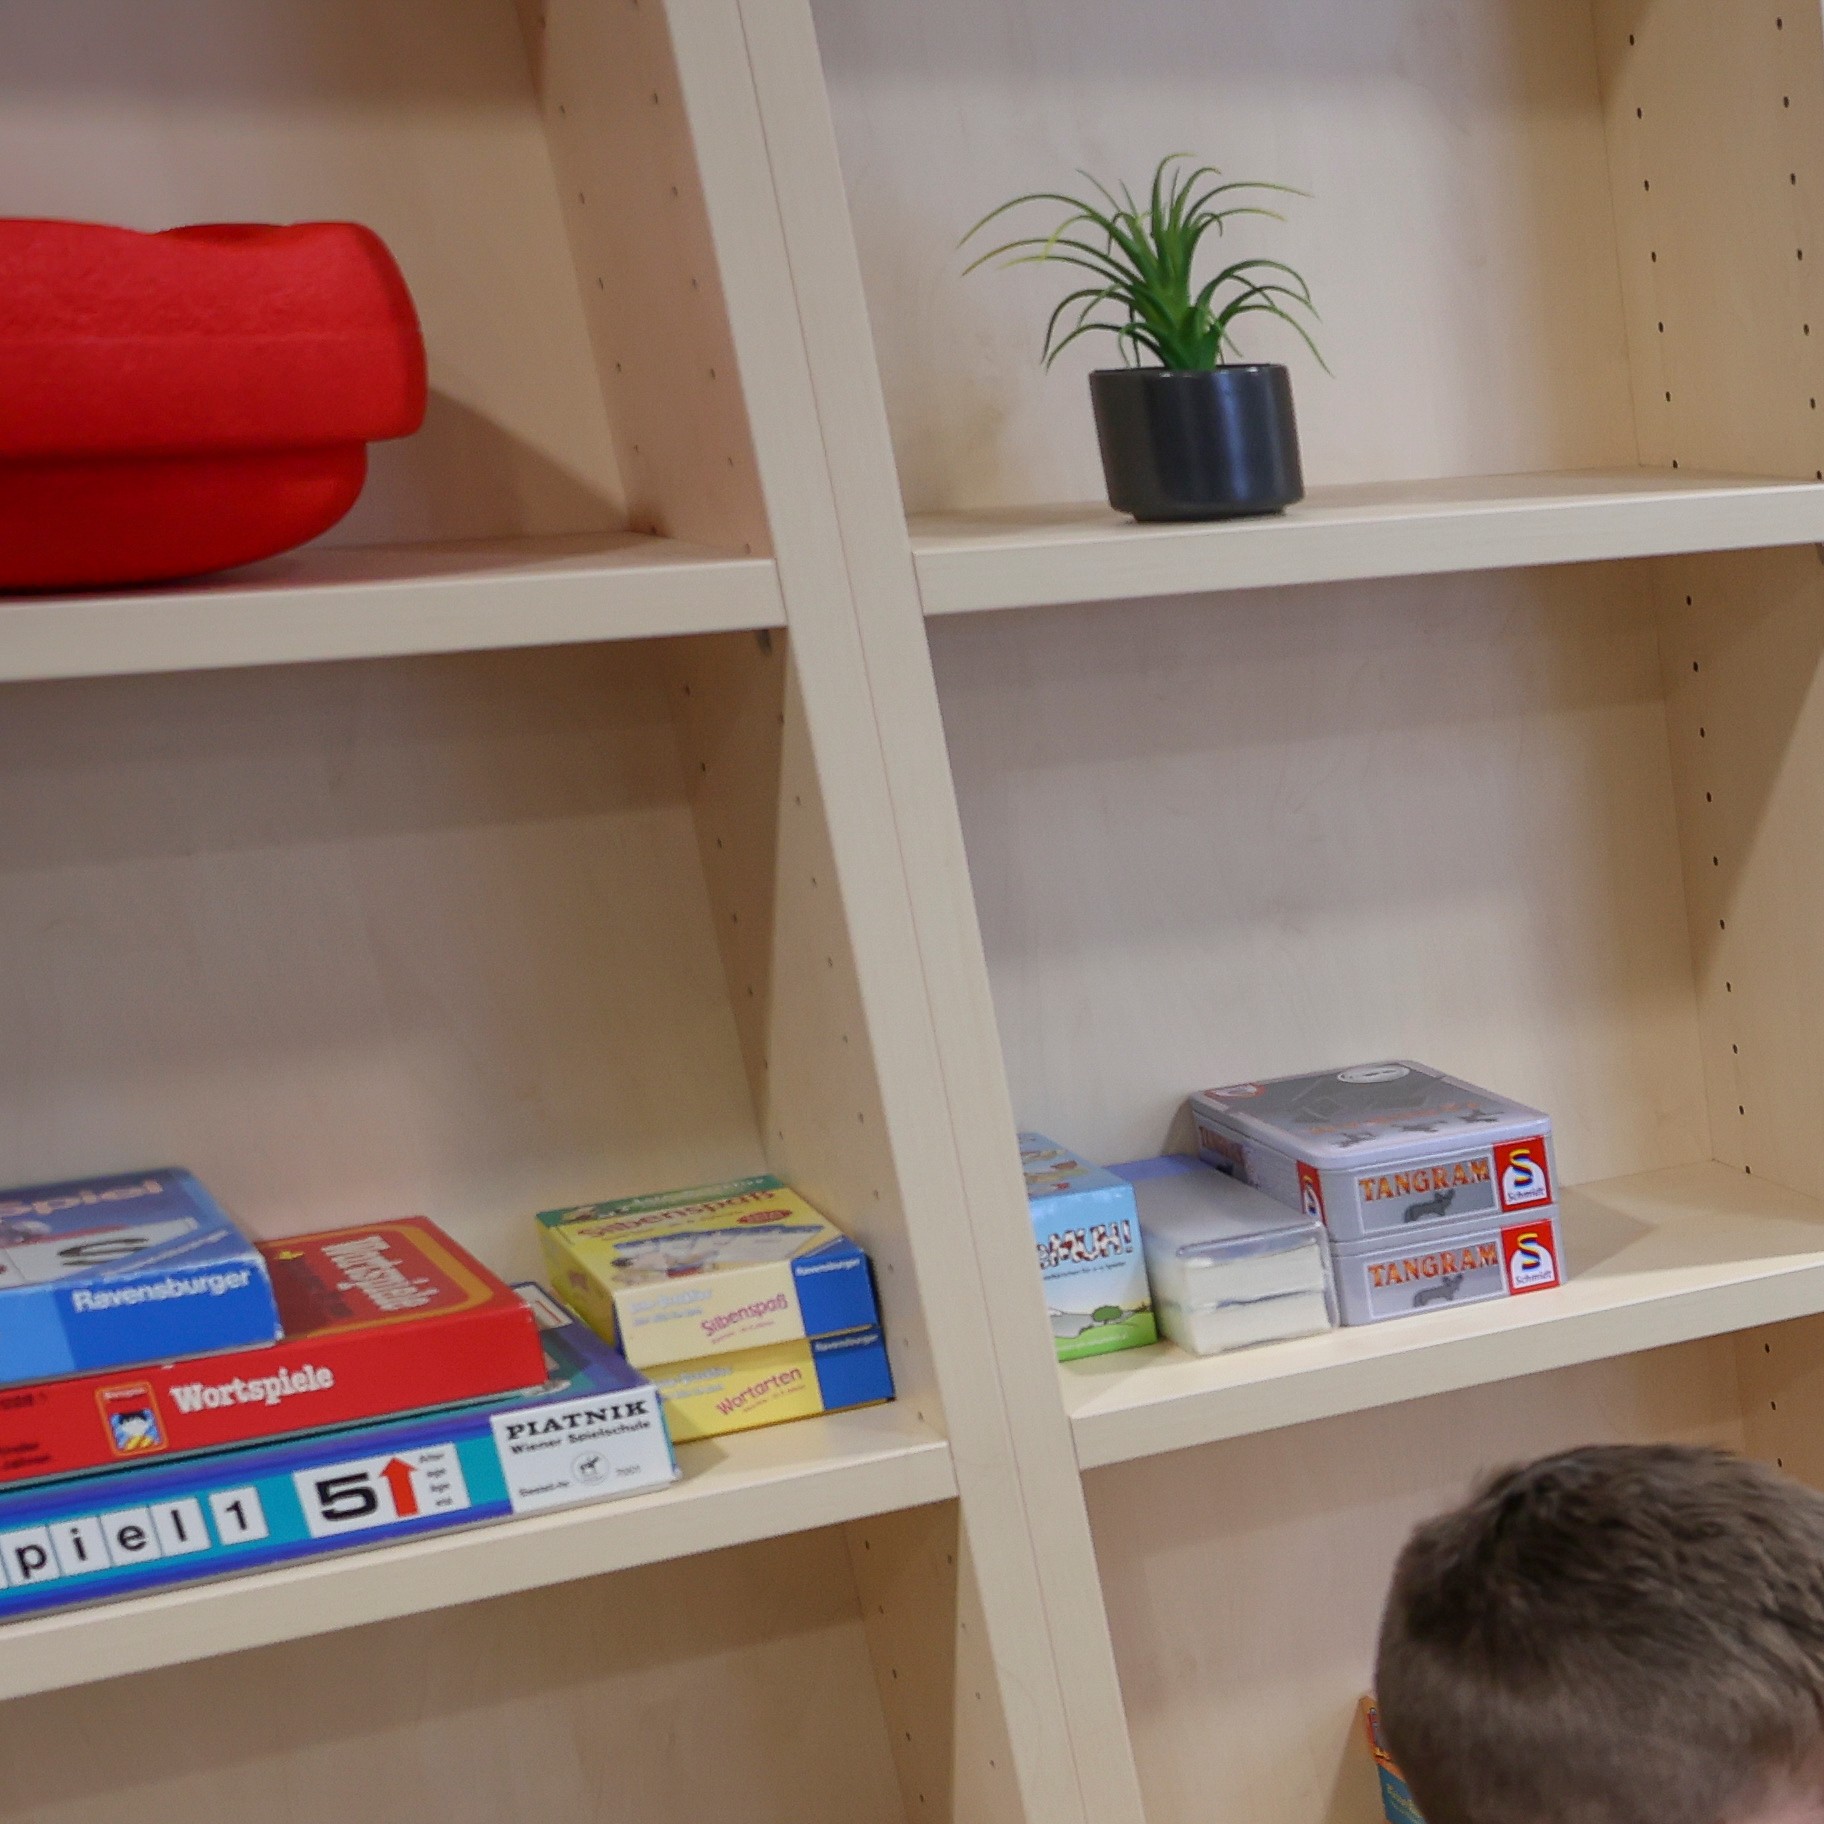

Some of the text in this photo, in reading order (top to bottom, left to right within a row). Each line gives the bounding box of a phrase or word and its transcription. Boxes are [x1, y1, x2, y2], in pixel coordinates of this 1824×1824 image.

[1358, 1158, 1491, 1202] TANGRAM
[1367, 1242, 1499, 1288] TANGRAM
[71, 1270, 249, 1313] Ravensburger
[701, 1294, 788, 1337] Silbenspaß
[168, 1364, 335, 1414] Wortspiele
[717, 1367, 802, 1417] Wortarten
[506, 1400, 650, 1441] PIATNIK
[510, 1421, 651, 1455] Wiener Spielschule
[225, 1499, 248, 1531] 1
[314, 1471, 379, 1522] 5
